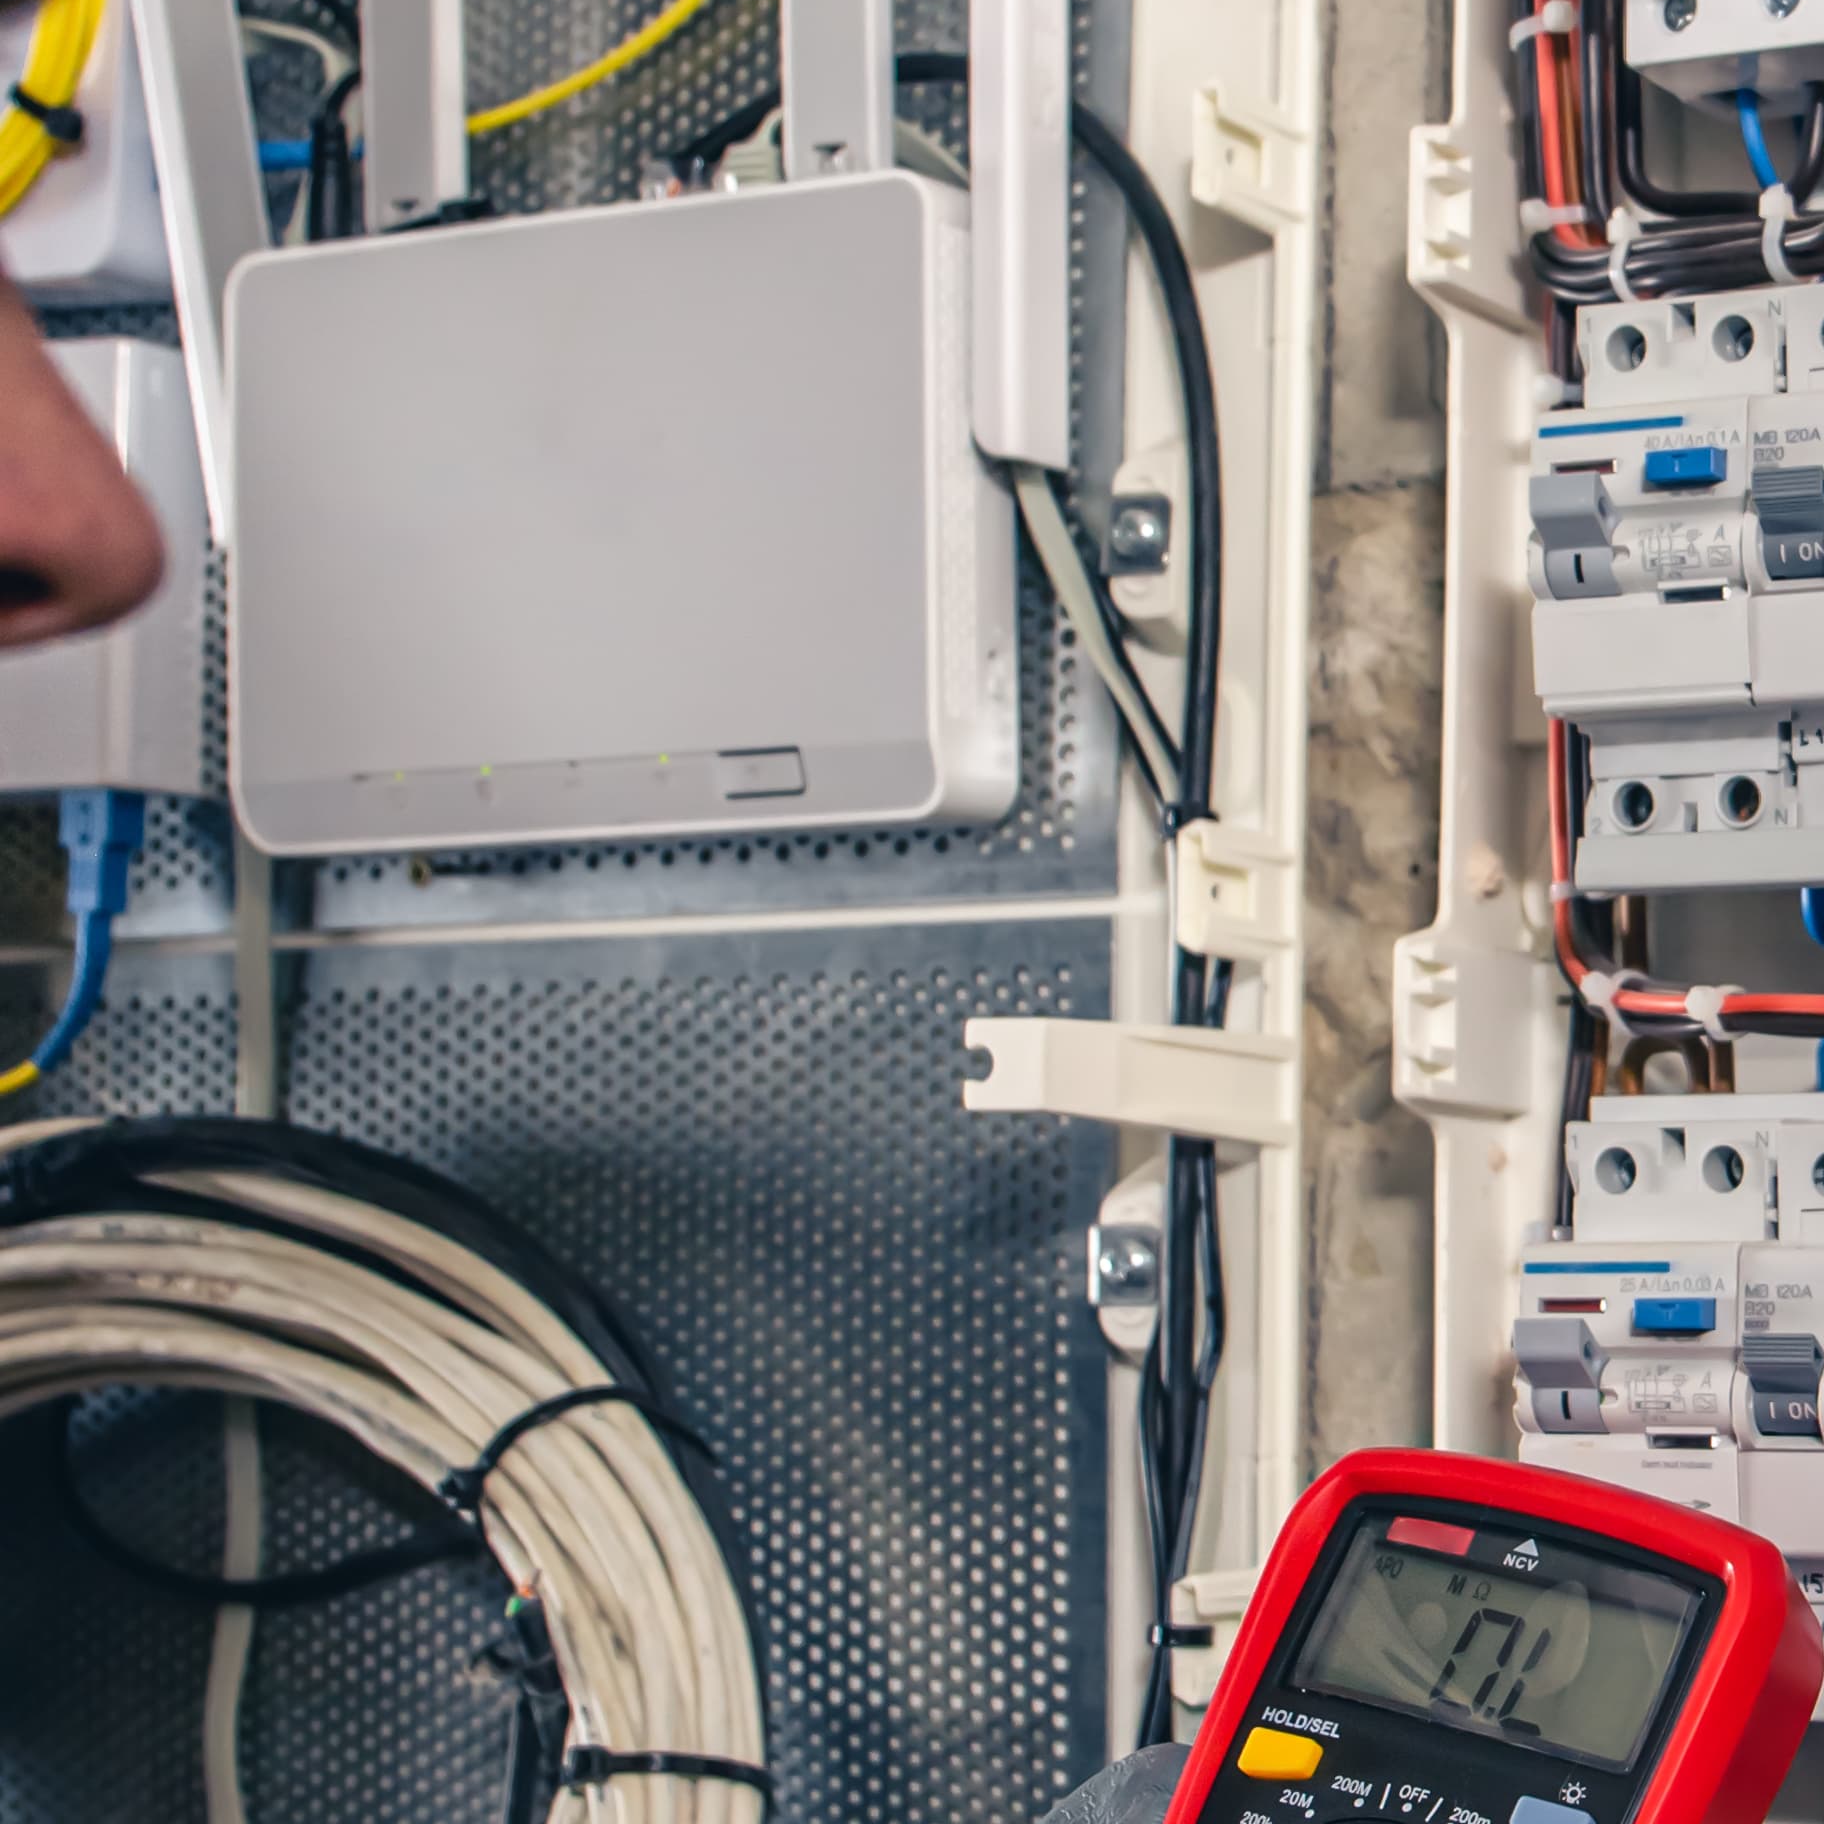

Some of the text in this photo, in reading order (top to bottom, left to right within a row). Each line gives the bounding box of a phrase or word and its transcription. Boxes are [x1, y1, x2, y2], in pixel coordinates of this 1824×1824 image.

[1767, 299, 1782, 316] N
[1785, 428, 1822, 444] 120A
[1753, 447, 1785, 462] B20
[1773, 807, 1789, 826] N
[1755, 1131, 1770, 1148] N
[1714, 1278, 1725, 1293] A
[1777, 1285, 1813, 1299] 120A
[1745, 1301, 1775, 1315] B20
[1503, 1552, 1539, 1573] NCV
[1261, 1705, 1342, 1740] HOLD/SEL
[1331, 1774, 1373, 1797] 200M
[1398, 1784, 1431, 1804] OFF
[1279, 1788, 1314, 1809] 20M
